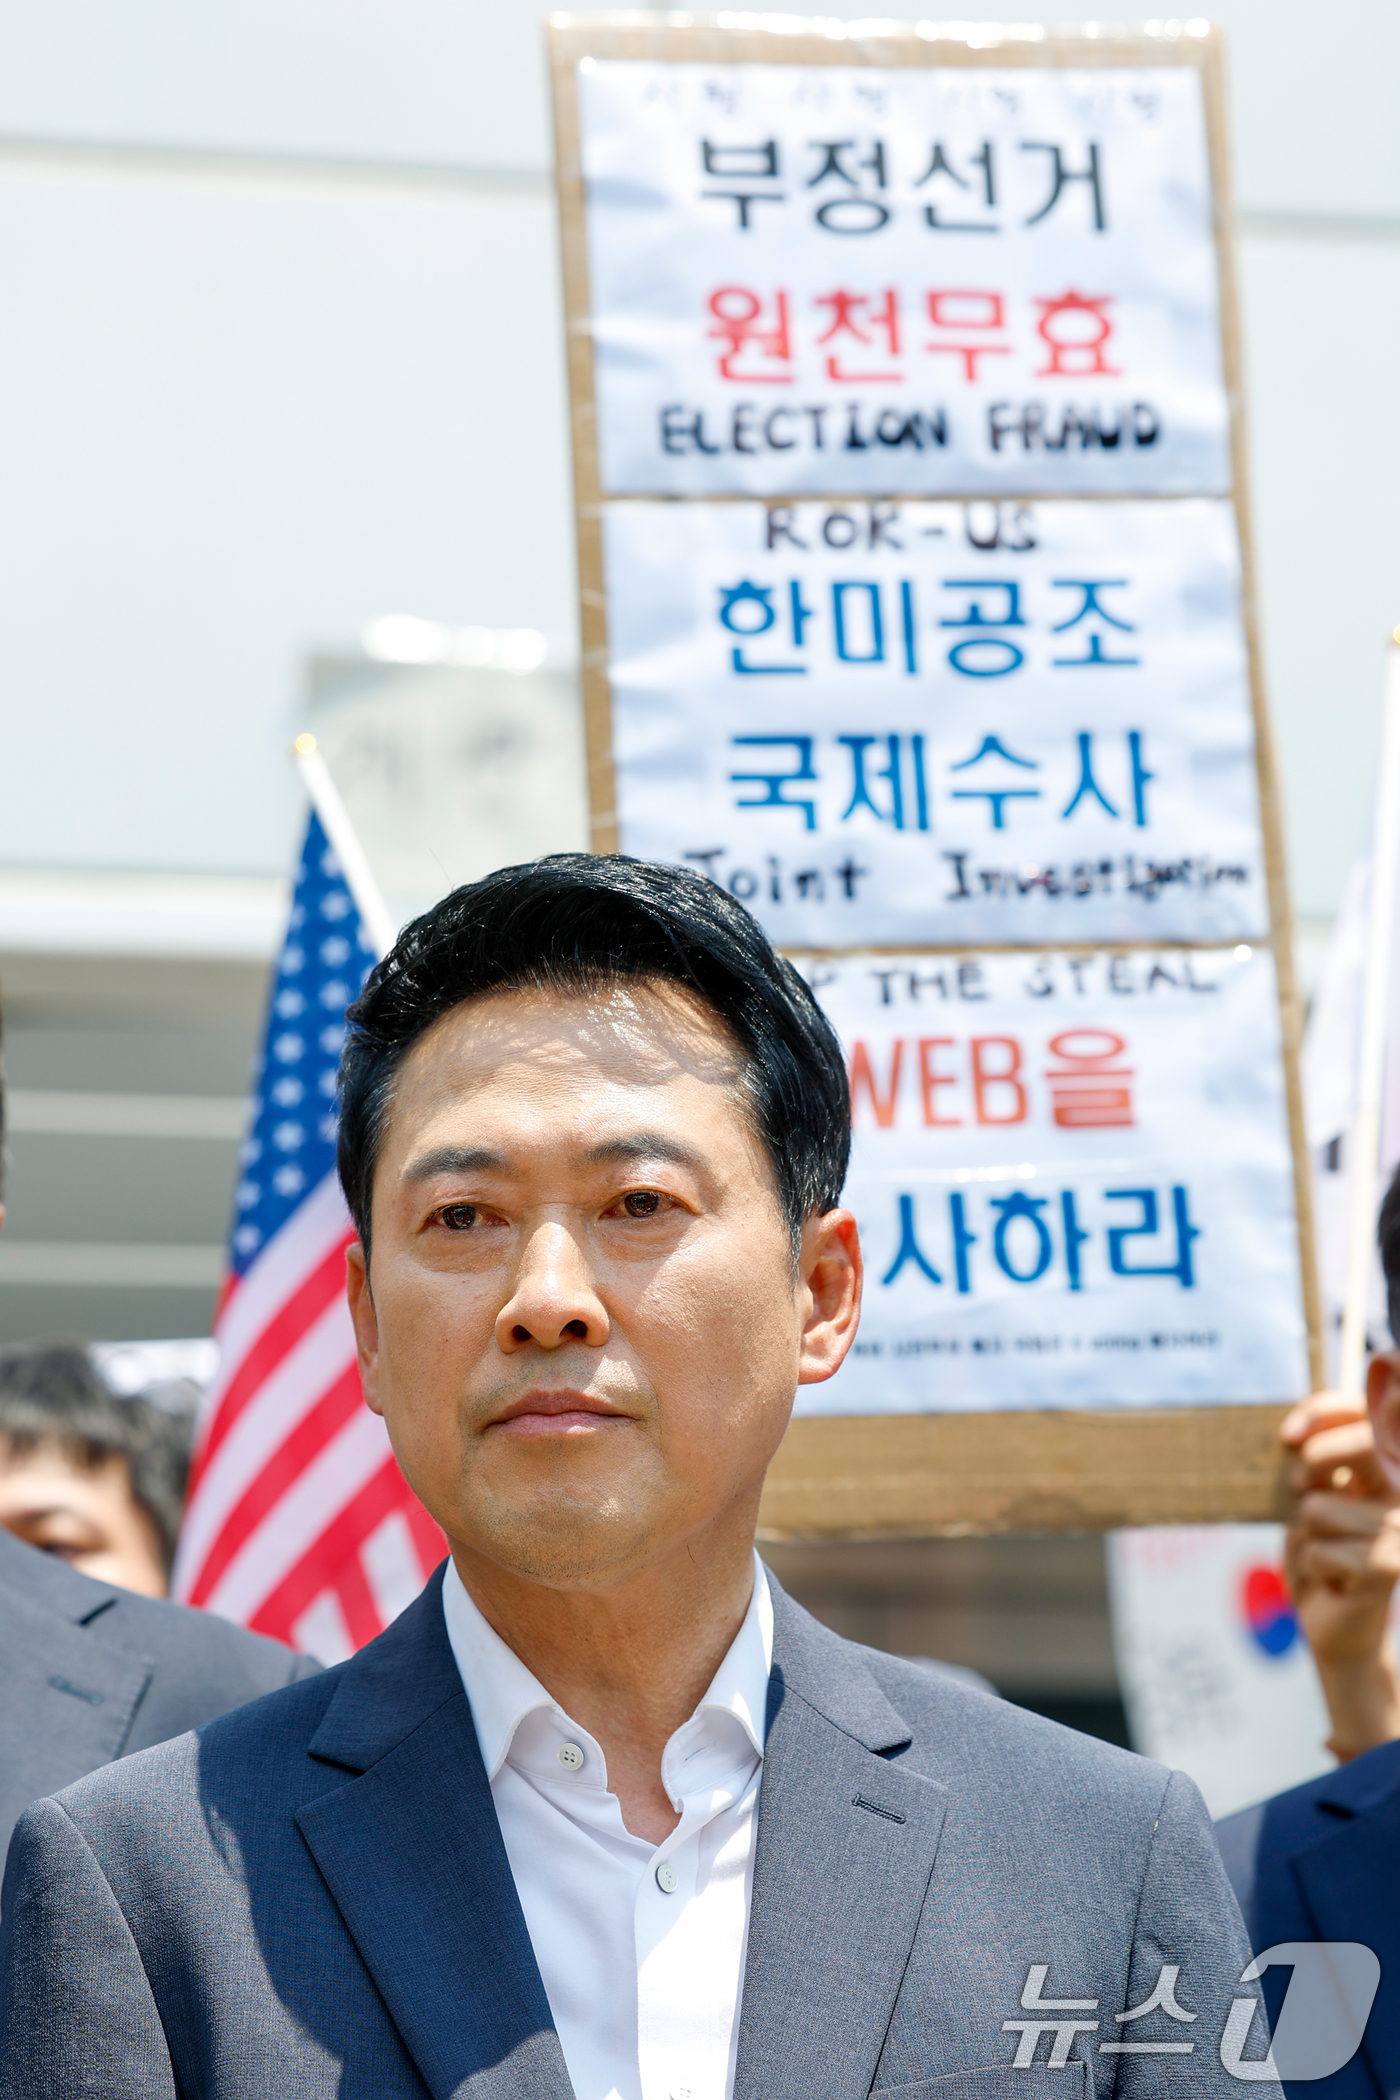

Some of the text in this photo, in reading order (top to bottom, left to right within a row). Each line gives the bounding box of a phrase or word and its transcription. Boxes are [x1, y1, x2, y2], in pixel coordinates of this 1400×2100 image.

[701, 138, 1108, 235] 부정선거
[706, 285, 1120, 384] 원천무효
[659, 403, 1162, 455] ELECTION FRAUD
[717, 579, 1141, 677] 한미공조
[729, 730, 1156, 831] 국제수사
[870, 958, 988, 1005] THE
[1024, 952, 1221, 999] STEAL
[857, 1184, 1202, 1295] 사하라
